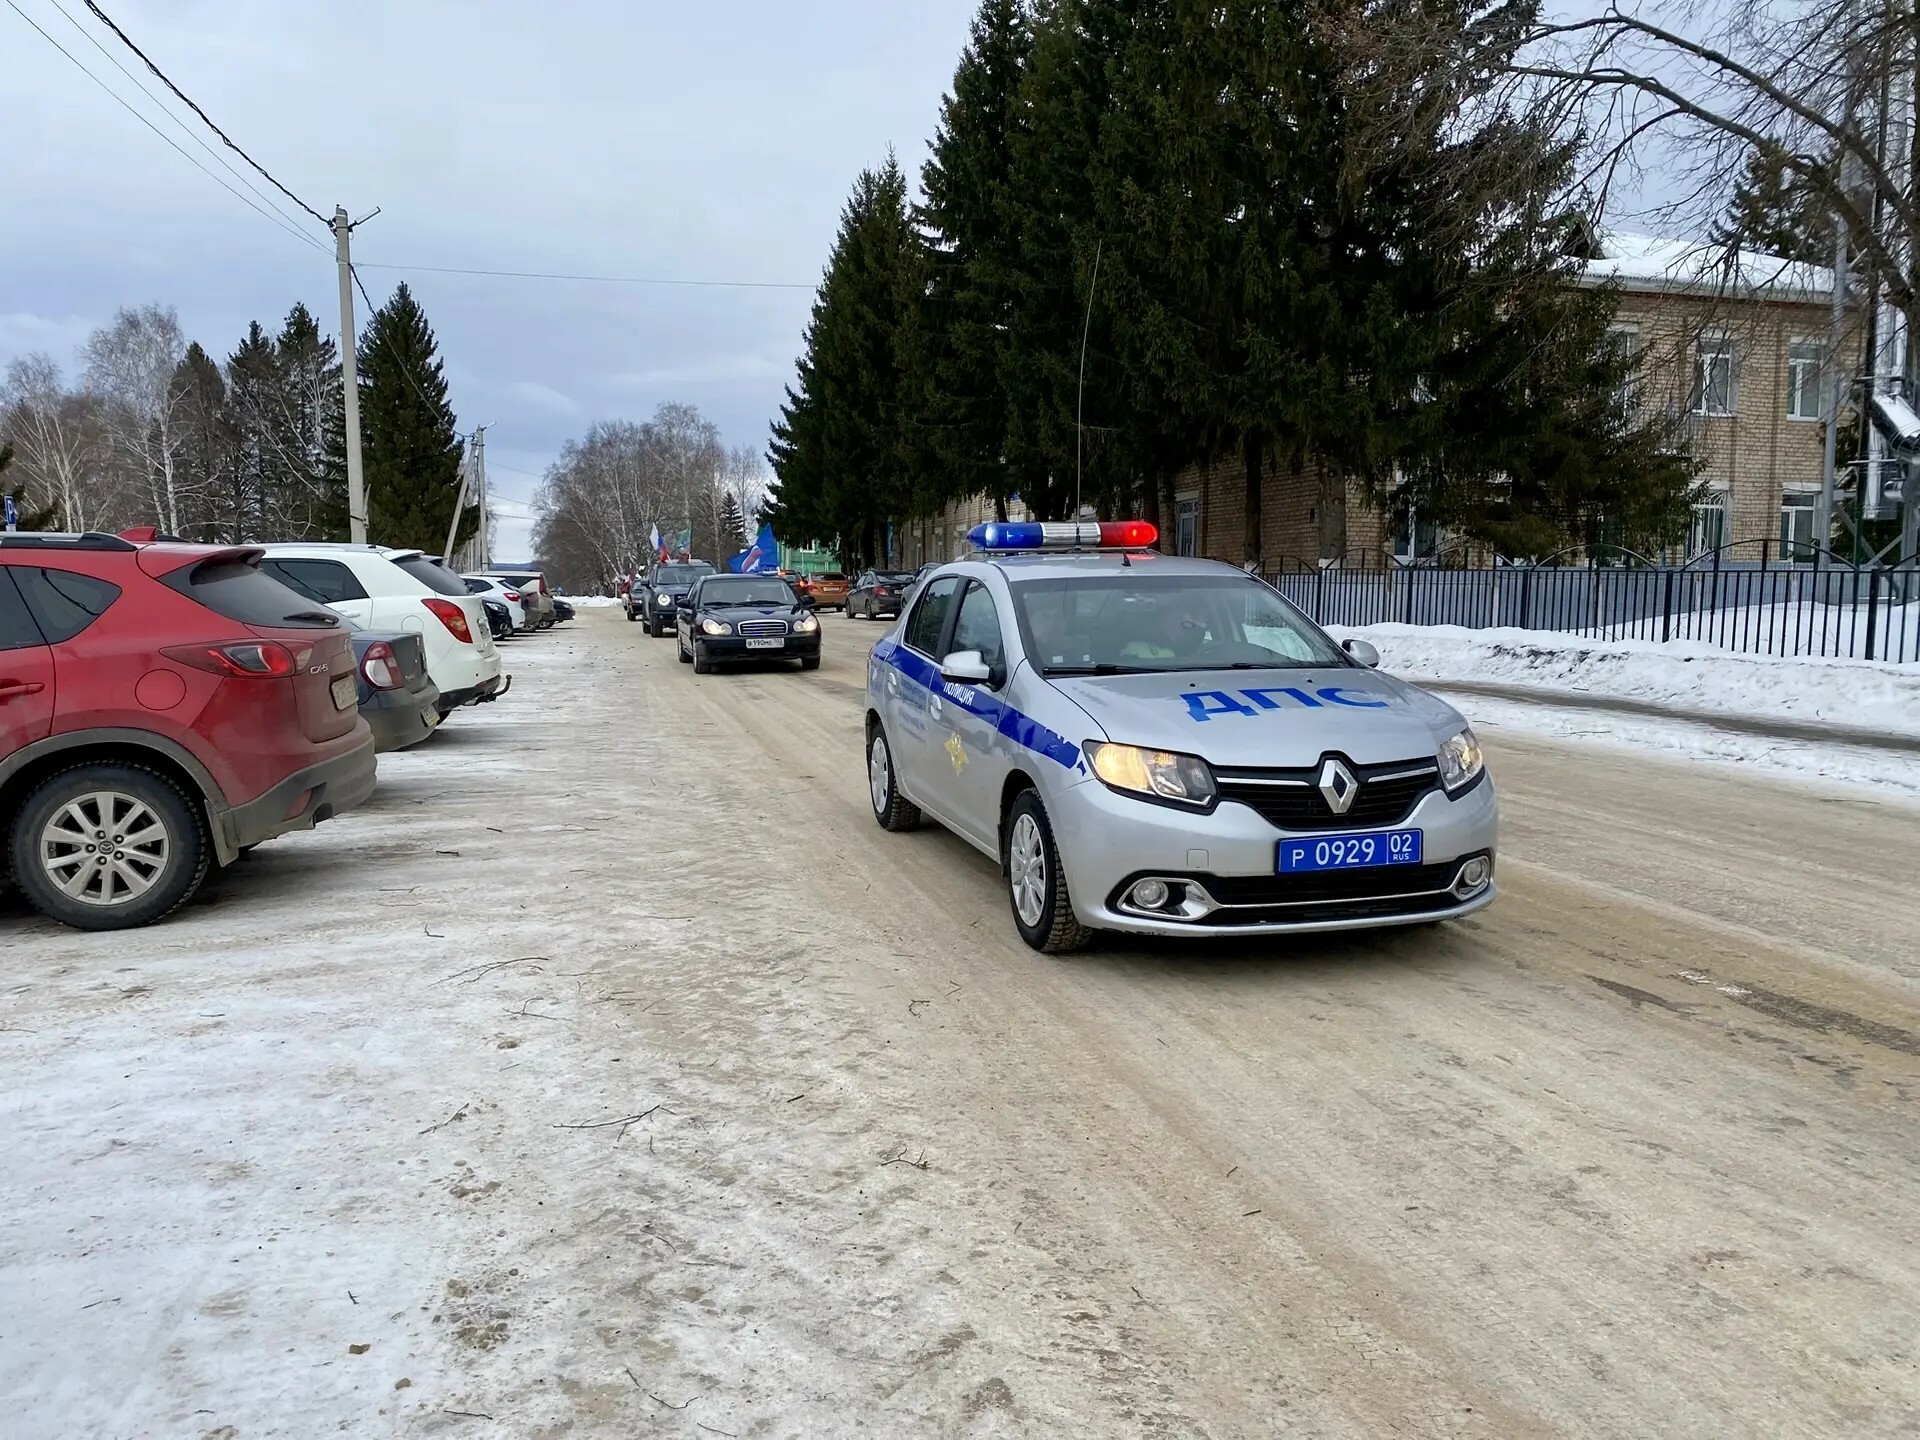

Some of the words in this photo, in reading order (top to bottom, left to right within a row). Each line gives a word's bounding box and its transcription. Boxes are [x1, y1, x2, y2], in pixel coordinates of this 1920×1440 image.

[310, 663, 329, 675] CX-5
[943, 682, 975, 706] ПОЛИЦИЯ
[1179, 687, 1389, 722] ДПС
[1315, 838, 1375, 866] 0929
[1390, 834, 1412, 853] 02
[1392, 853, 1410, 861] RUS
